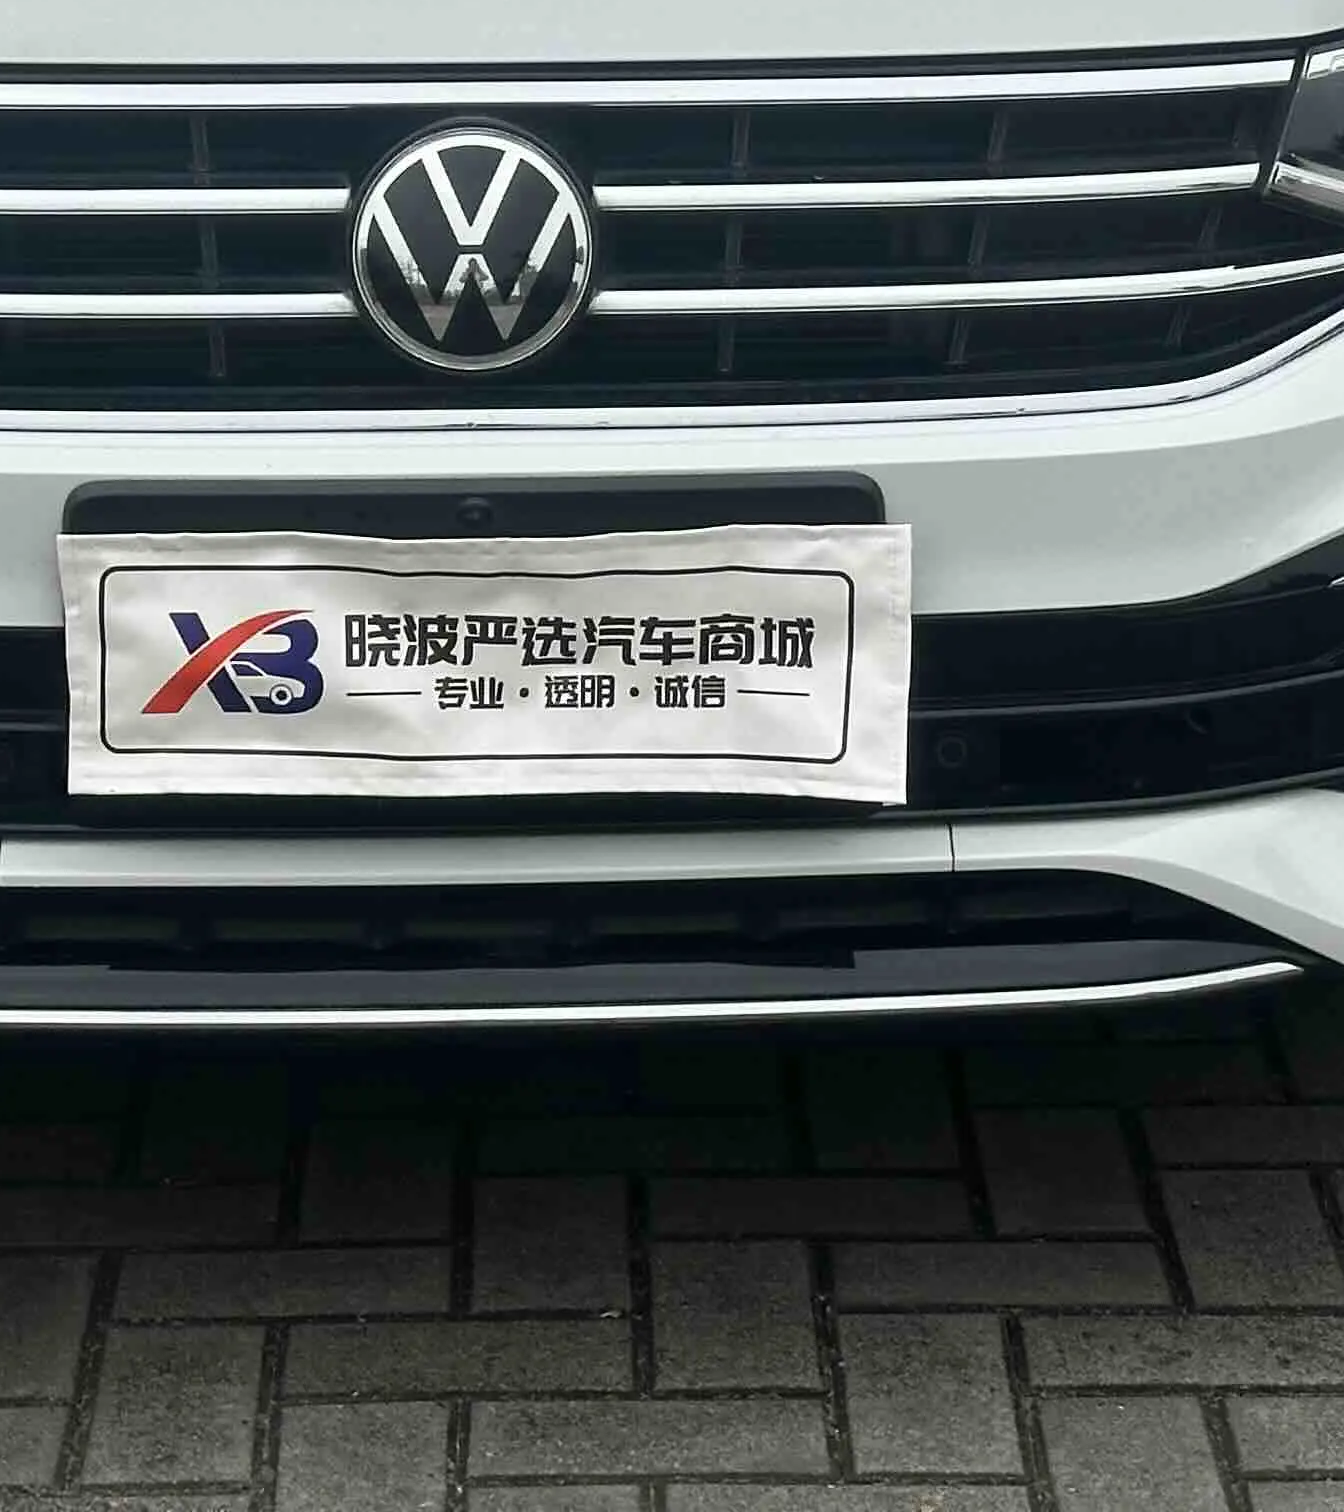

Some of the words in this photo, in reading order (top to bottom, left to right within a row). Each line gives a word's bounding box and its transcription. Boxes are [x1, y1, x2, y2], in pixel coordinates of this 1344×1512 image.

[343, 613, 816, 669] 晓波严选汽车商城
